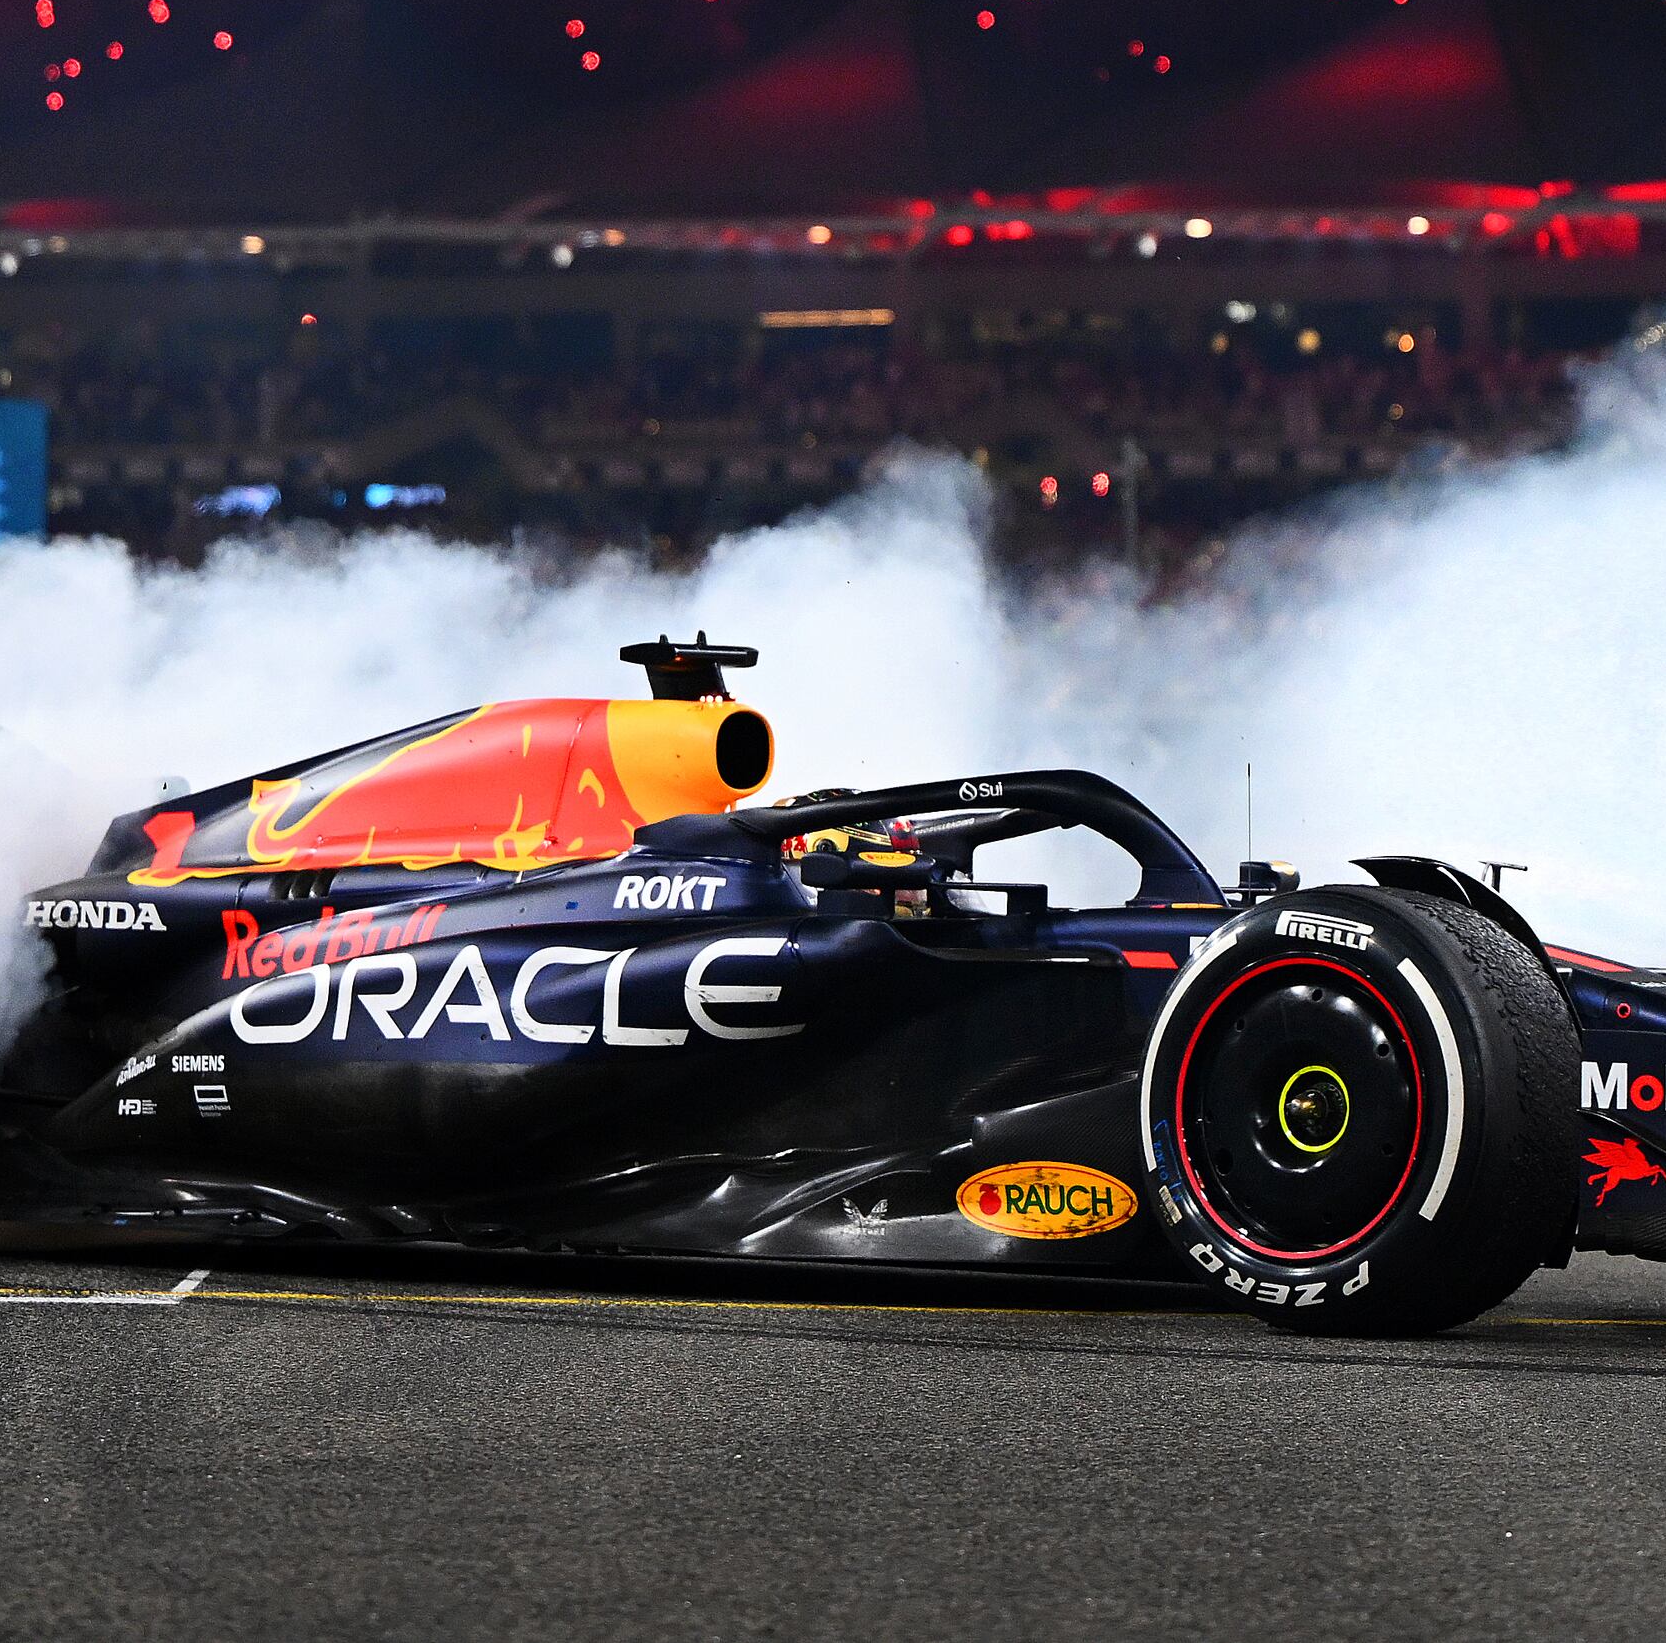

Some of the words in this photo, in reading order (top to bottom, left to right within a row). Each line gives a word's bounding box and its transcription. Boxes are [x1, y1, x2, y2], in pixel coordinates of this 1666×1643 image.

[978, 781, 1003, 798] Sui
[614, 874, 727, 911] ROKT
[23, 899, 167, 932] HONDA
[1275, 910, 1375, 951] PIRELLI
[230, 937, 806, 1047] ORACLE
[172, 1055, 225, 1073] SIEMENS
[1004, 1184, 1114, 1217] RAUCH
[1189, 1243, 1327, 1307] ZERO
[1342, 1260, 1370, 1296] P
